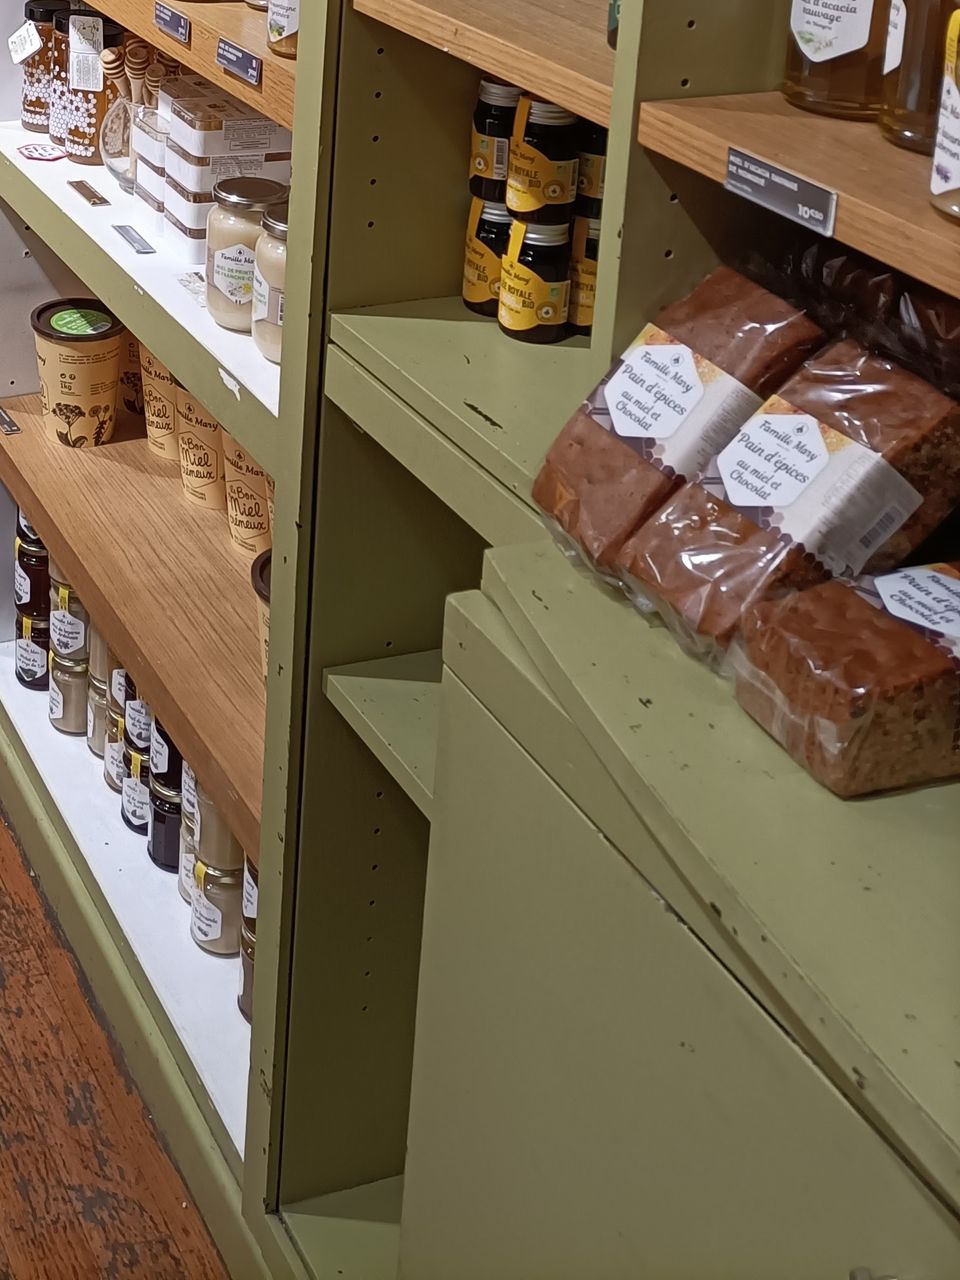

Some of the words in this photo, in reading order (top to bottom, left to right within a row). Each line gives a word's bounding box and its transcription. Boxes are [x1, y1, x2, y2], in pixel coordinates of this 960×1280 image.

[802, 7, 842, 25] sauvage
[514, 166, 539, 180] ROYALE
[221, 253, 242, 263] Famille
[235, 268, 255, 276] PRINT
[507, 283, 533, 300] ROYALE
[521, 300, 535, 310] BIO
[641, 351, 670, 376] Famille
[671, 372, 693, 394] Mary
[148, 390, 164, 403] Bon
[622, 363, 647, 388] Pain
[645, 382, 687, 416] d'épices
[615, 400, 652, 431] Chocolat
[621, 390, 634, 401] au
[633, 398, 654, 415] miel
[650, 411, 662, 421] et
[195, 415, 218, 433] Mary
[187, 438, 206, 451] Bon
[759, 420, 794, 445] Famille
[793, 441, 818, 463] Mary
[180, 445, 212, 468] Miel
[737, 432, 765, 457] Pain
[764, 451, 810, 484] d'épices
[246, 465, 264, 478] Mar
[736, 459, 750, 471] au
[749, 468, 774, 485] miel
[770, 481, 782, 491] et
[237, 486, 257, 501] Bon
[730, 469, 772, 500] Chocolat
[229, 493, 263, 518] Miel
[900, 573, 932, 596] Pain
[890, 594, 941, 625] Chocolat
